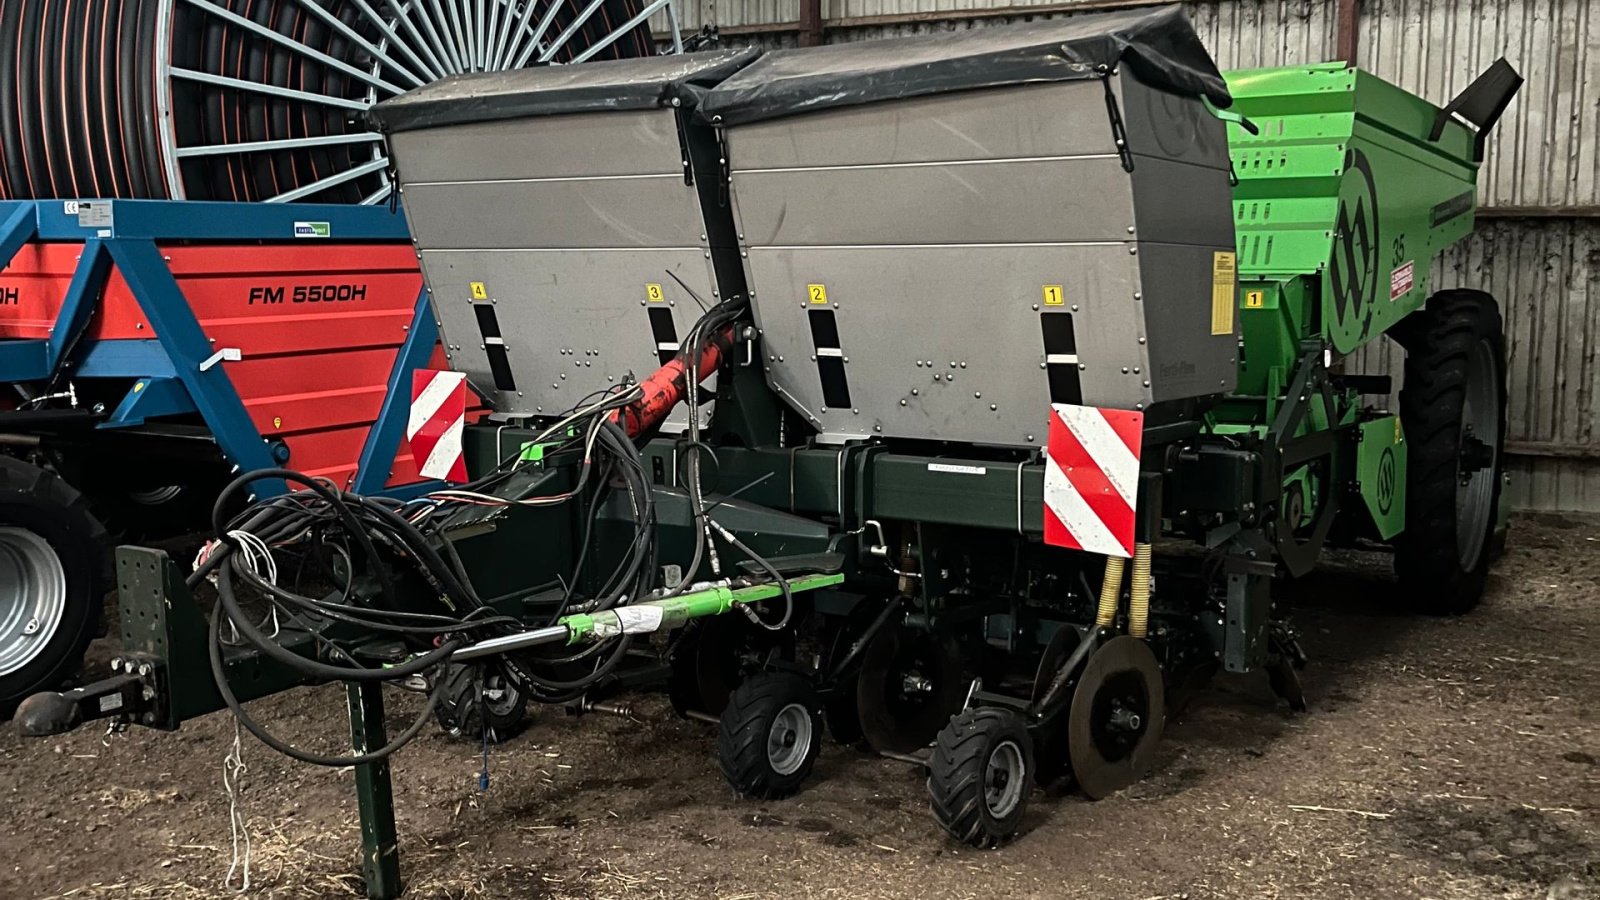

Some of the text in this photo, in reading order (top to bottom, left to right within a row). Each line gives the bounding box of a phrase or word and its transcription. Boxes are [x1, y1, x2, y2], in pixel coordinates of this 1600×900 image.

[1392, 233, 1405, 268] 35
[248, 284, 367, 305] FM 5500H
[475, 285, 482, 296] 4
[650, 286, 659, 299] 3
[812, 287, 822, 301] 2
[1049, 288, 1056, 302] 1
[1250, 293, 1257, 305] 1
